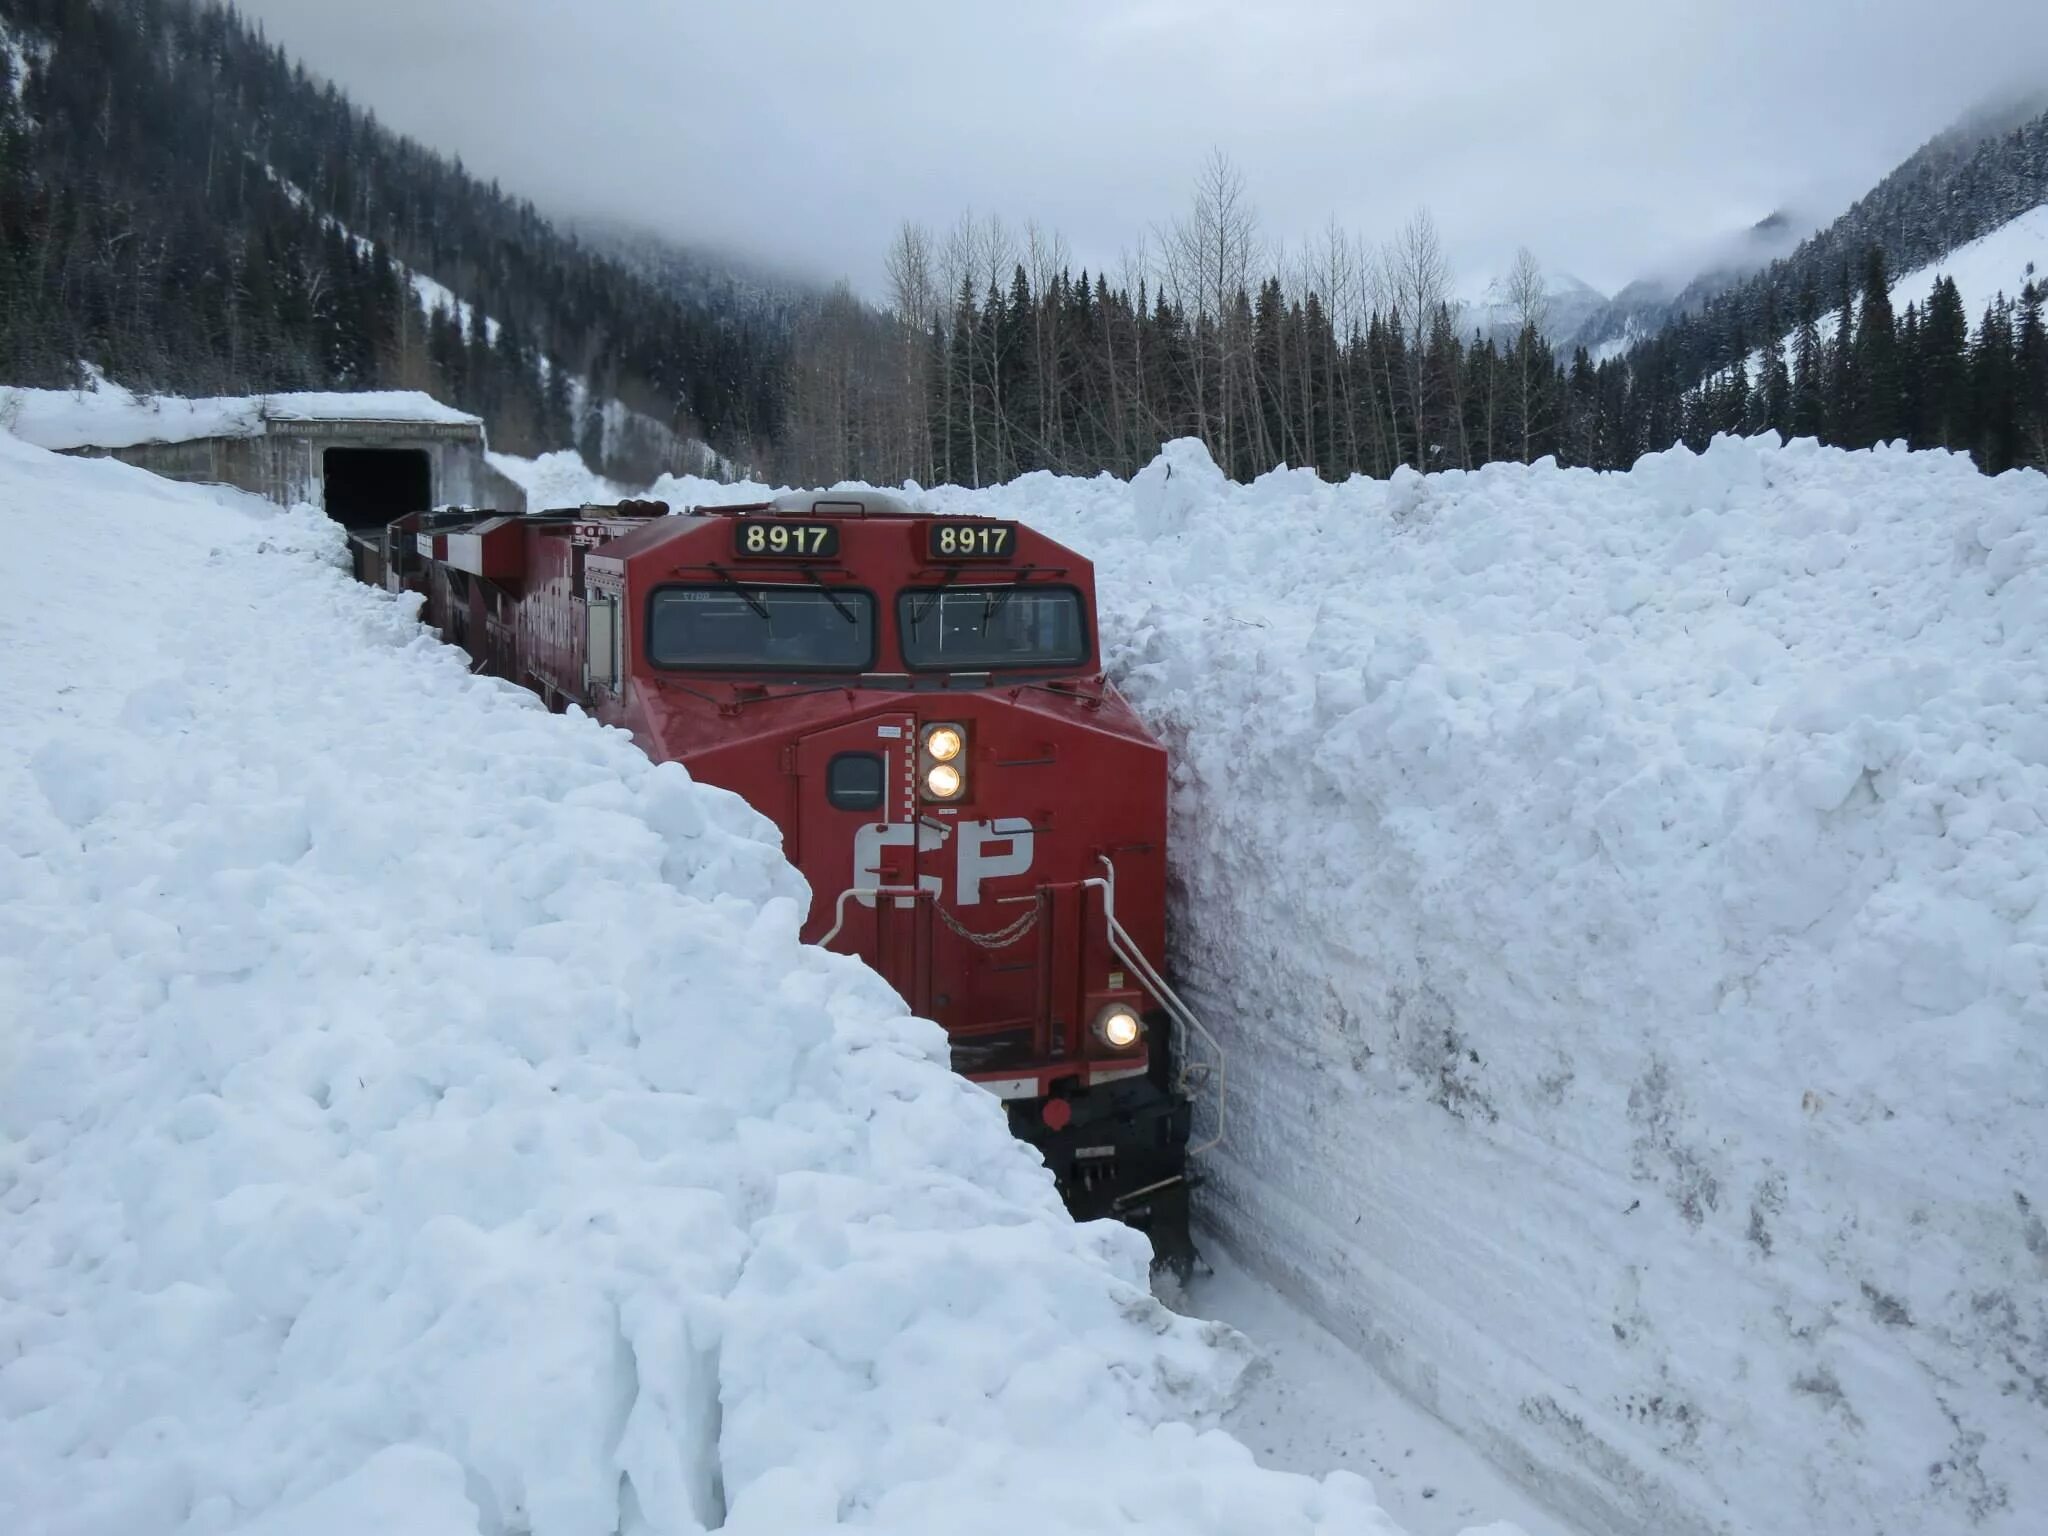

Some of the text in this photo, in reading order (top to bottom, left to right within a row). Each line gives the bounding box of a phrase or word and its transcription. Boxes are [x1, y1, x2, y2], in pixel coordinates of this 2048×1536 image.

[275, 422, 326, 436] Mount
[746, 525, 828, 553] 8917
[940, 527, 1007, 553] 8917
[854, 817, 1034, 908] CP
